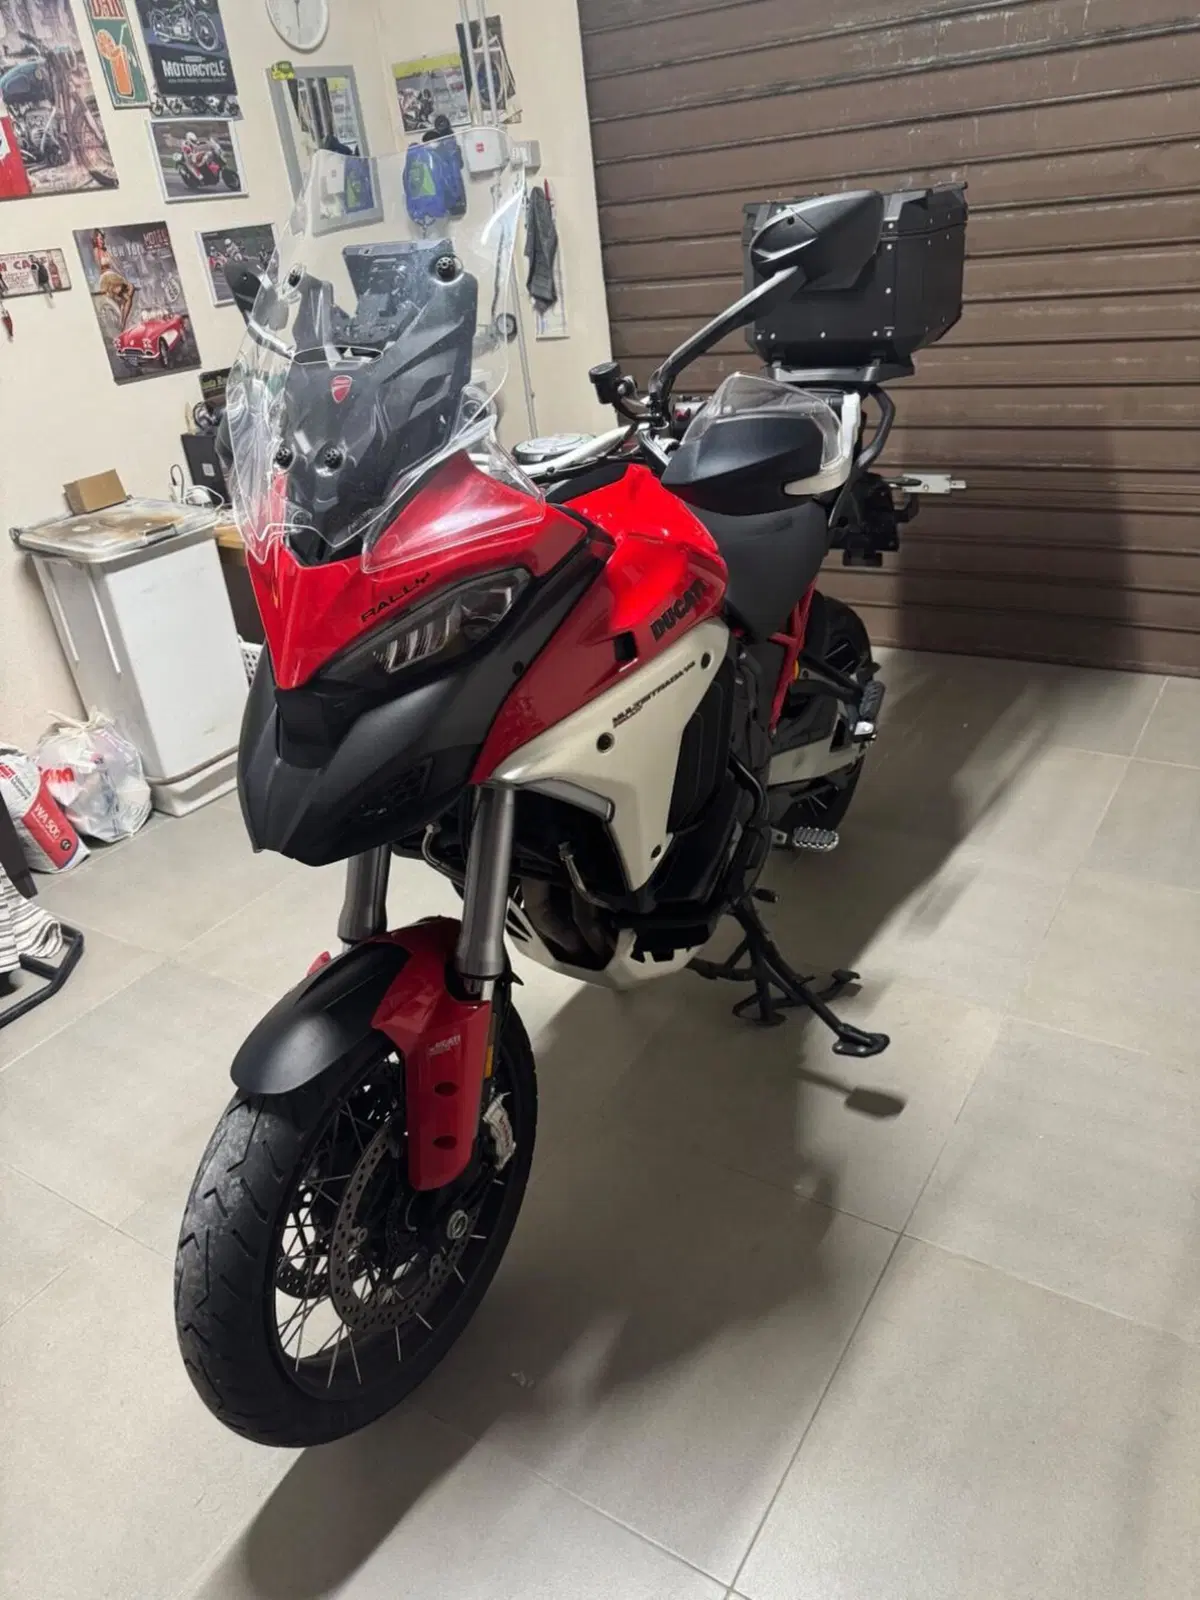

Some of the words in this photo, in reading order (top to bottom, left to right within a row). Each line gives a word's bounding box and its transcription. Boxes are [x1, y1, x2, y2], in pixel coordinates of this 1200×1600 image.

[161, 59, 228, 77] MOTORCYCLE
[361, 571, 431, 623] RALLY
[34, 803, 49, 823] WA
[45, 819, 60, 841] 500
